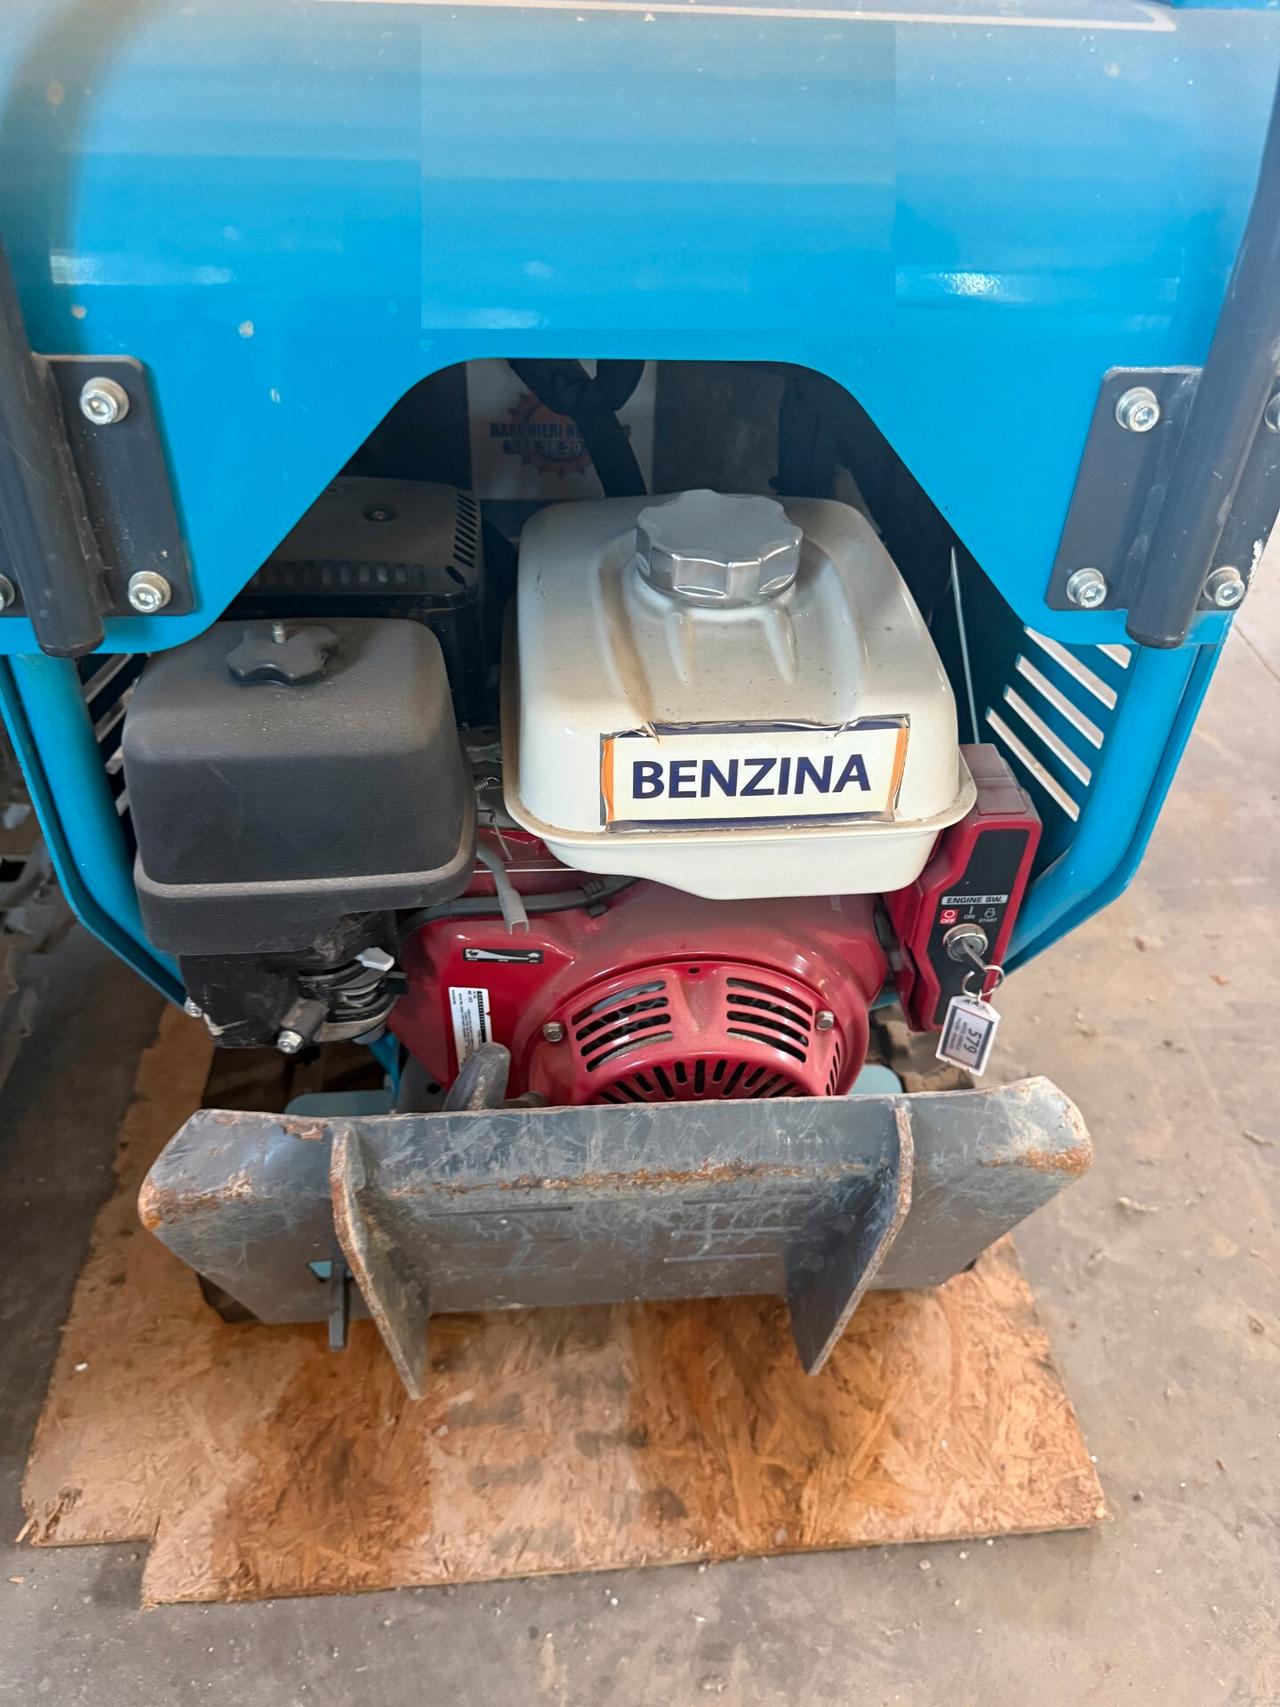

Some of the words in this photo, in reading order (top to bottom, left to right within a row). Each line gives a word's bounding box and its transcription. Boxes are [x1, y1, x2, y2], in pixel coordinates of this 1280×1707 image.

[632, 754, 871, 799] BENZINA
[946, 896, 982, 904] ENGINE
[964, 1028, 982, 1054] 579
